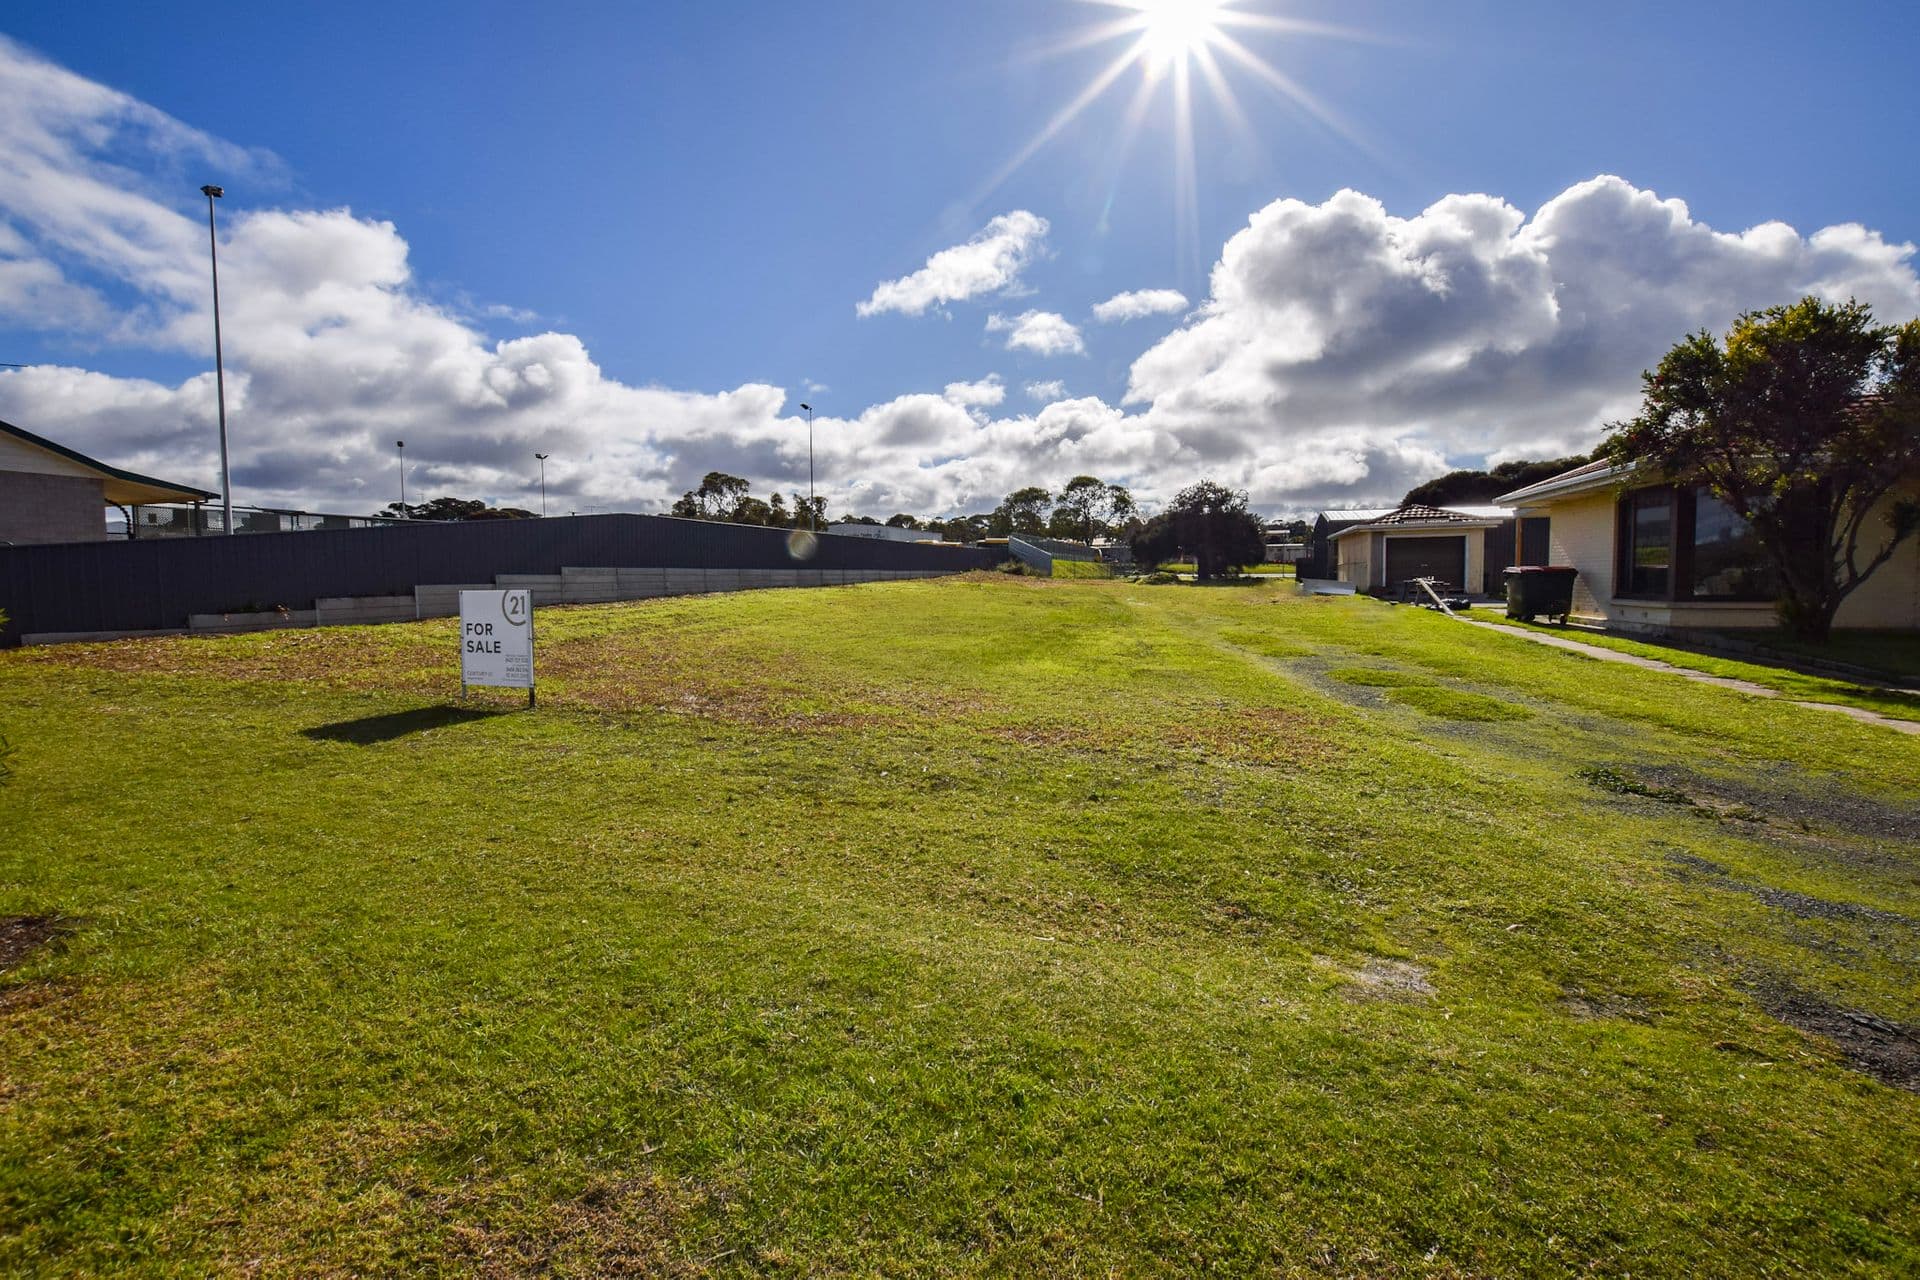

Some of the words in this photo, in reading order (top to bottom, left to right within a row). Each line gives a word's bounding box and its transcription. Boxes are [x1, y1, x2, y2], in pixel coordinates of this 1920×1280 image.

[510, 596, 525, 615] 21
[466, 623, 493, 636] FOR
[466, 640, 502, 654] SALE
